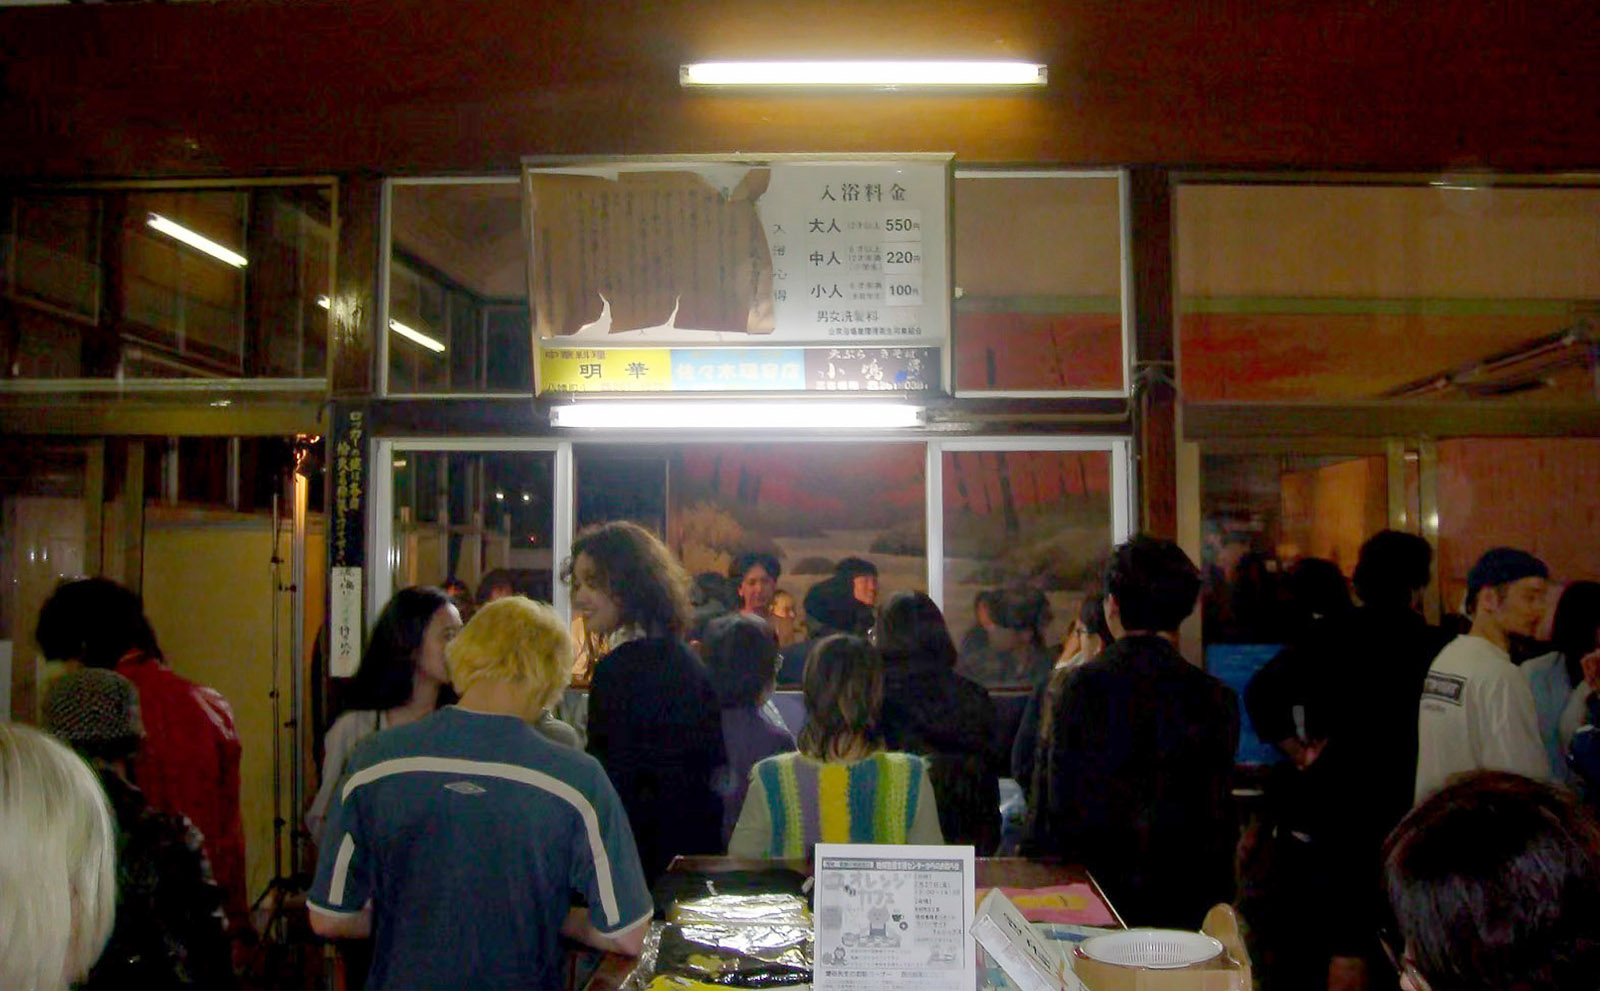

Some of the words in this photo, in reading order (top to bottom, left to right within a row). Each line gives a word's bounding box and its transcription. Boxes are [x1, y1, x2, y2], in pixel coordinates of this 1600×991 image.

[821, 182, 907, 203] 入浴料金
[808, 217, 842, 234] 大人
[885, 218, 921, 232] 550円
[809, 250, 842, 267] 中人
[810, 283, 844, 299] 小人
[545, 349, 606, 361] 中華料理
